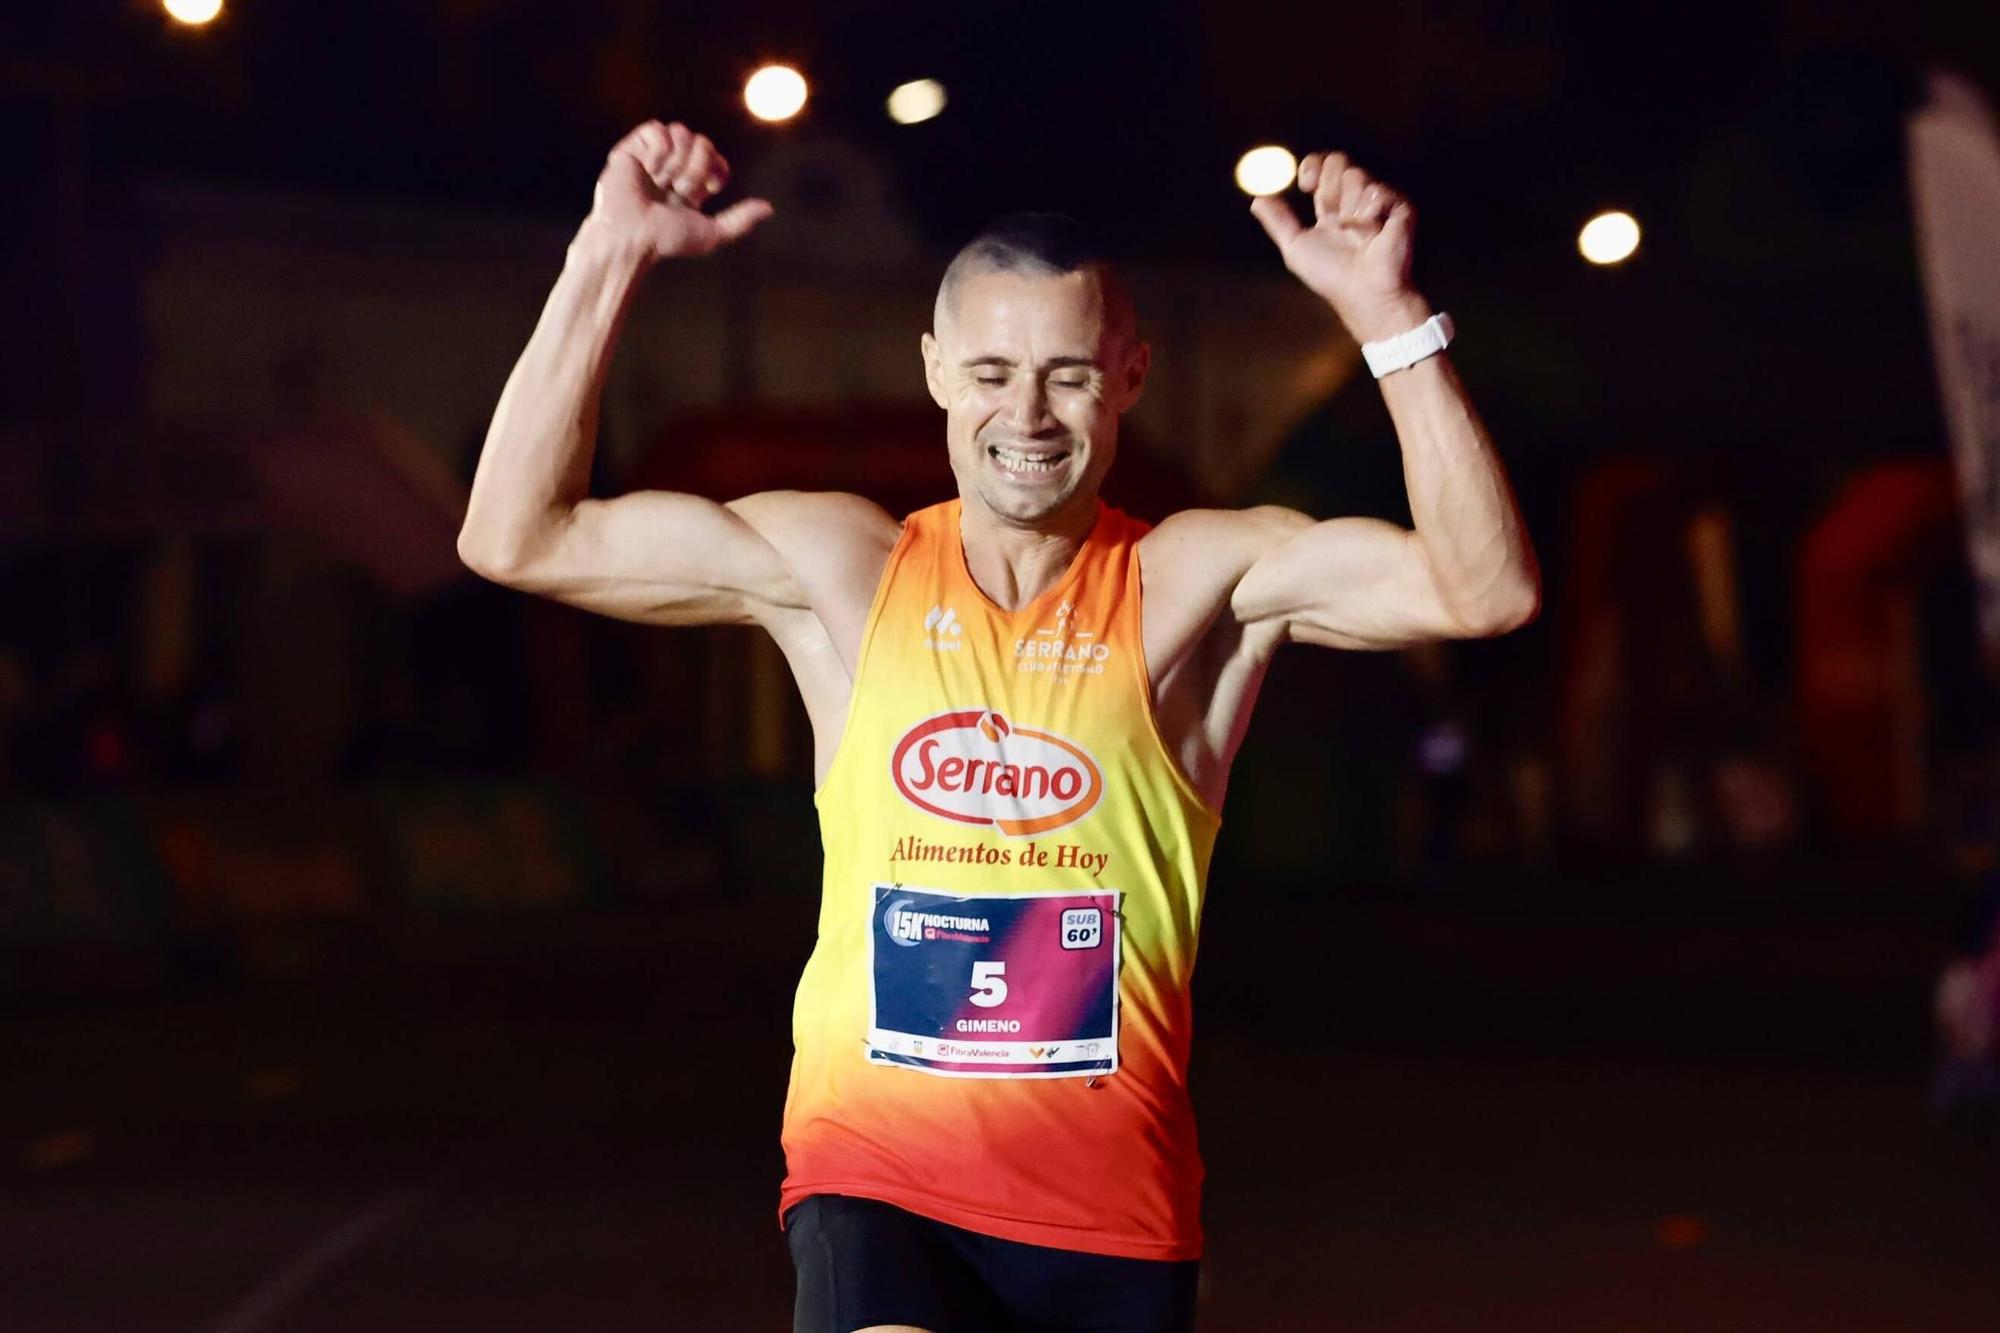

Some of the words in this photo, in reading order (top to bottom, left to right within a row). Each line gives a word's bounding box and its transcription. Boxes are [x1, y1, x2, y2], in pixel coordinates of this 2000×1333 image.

[1014, 639, 1111, 661] SERRANO
[910, 739, 1082, 801] Serrano
[890, 836, 1012, 866] Alimentos
[1019, 842, 1048, 868] de
[1054, 845, 1109, 877] Hoy
[892, 910, 925, 940] 15K
[924, 913, 990, 932] NOCTURNA
[1066, 913, 1097, 925] SUB
[1066, 927, 1098, 942] 60'
[968, 961, 1008, 1008] 5
[956, 1019, 1021, 1033] GIMENO
[950, 1046, 1010, 1057] FibraValencia
